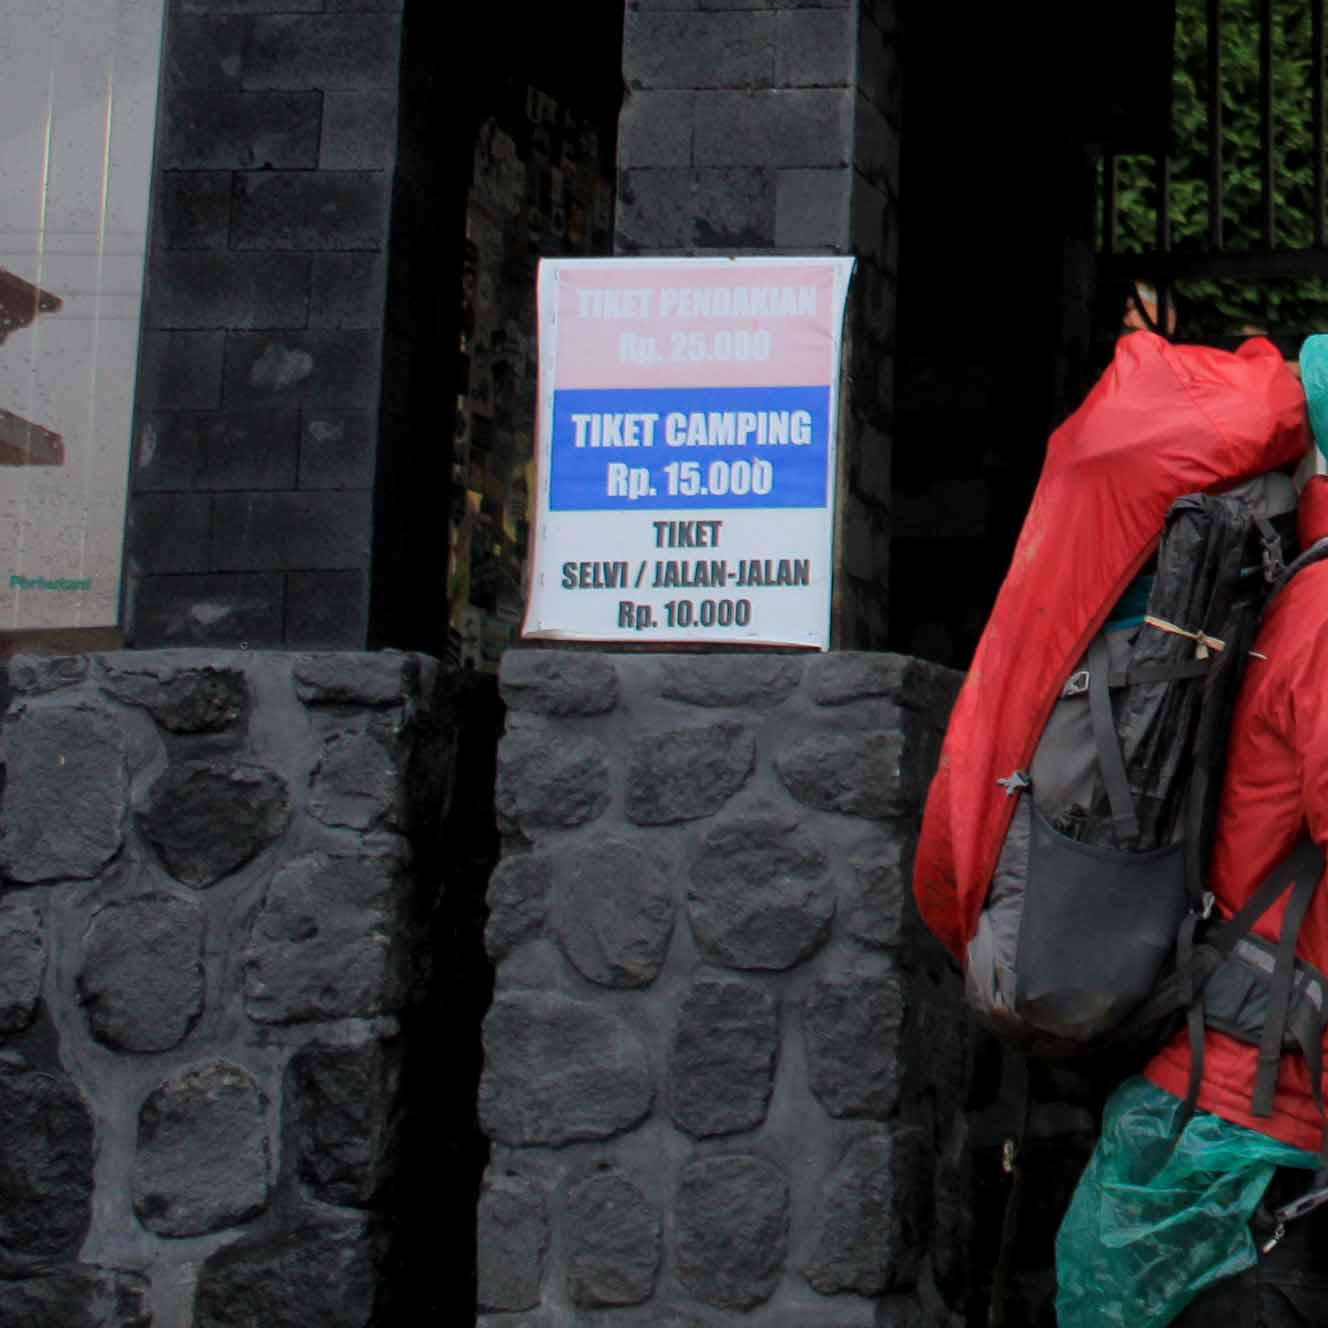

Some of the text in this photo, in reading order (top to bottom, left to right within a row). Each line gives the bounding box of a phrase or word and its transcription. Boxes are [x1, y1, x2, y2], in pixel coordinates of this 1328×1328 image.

[577, 284, 817, 319] TIKET PENDAKIAN
[618, 328, 772, 365] Rp. 25.000
[571, 410, 812, 448] TIKET CAMPING
[606, 459, 773, 500] Rp. 15.000
[652, 521, 722, 549] TIKET
[561, 560, 629, 590] SELVI
[651, 558, 811, 588] JALAN-JALAN
[617, 598, 753, 631] Rp. 10.000
